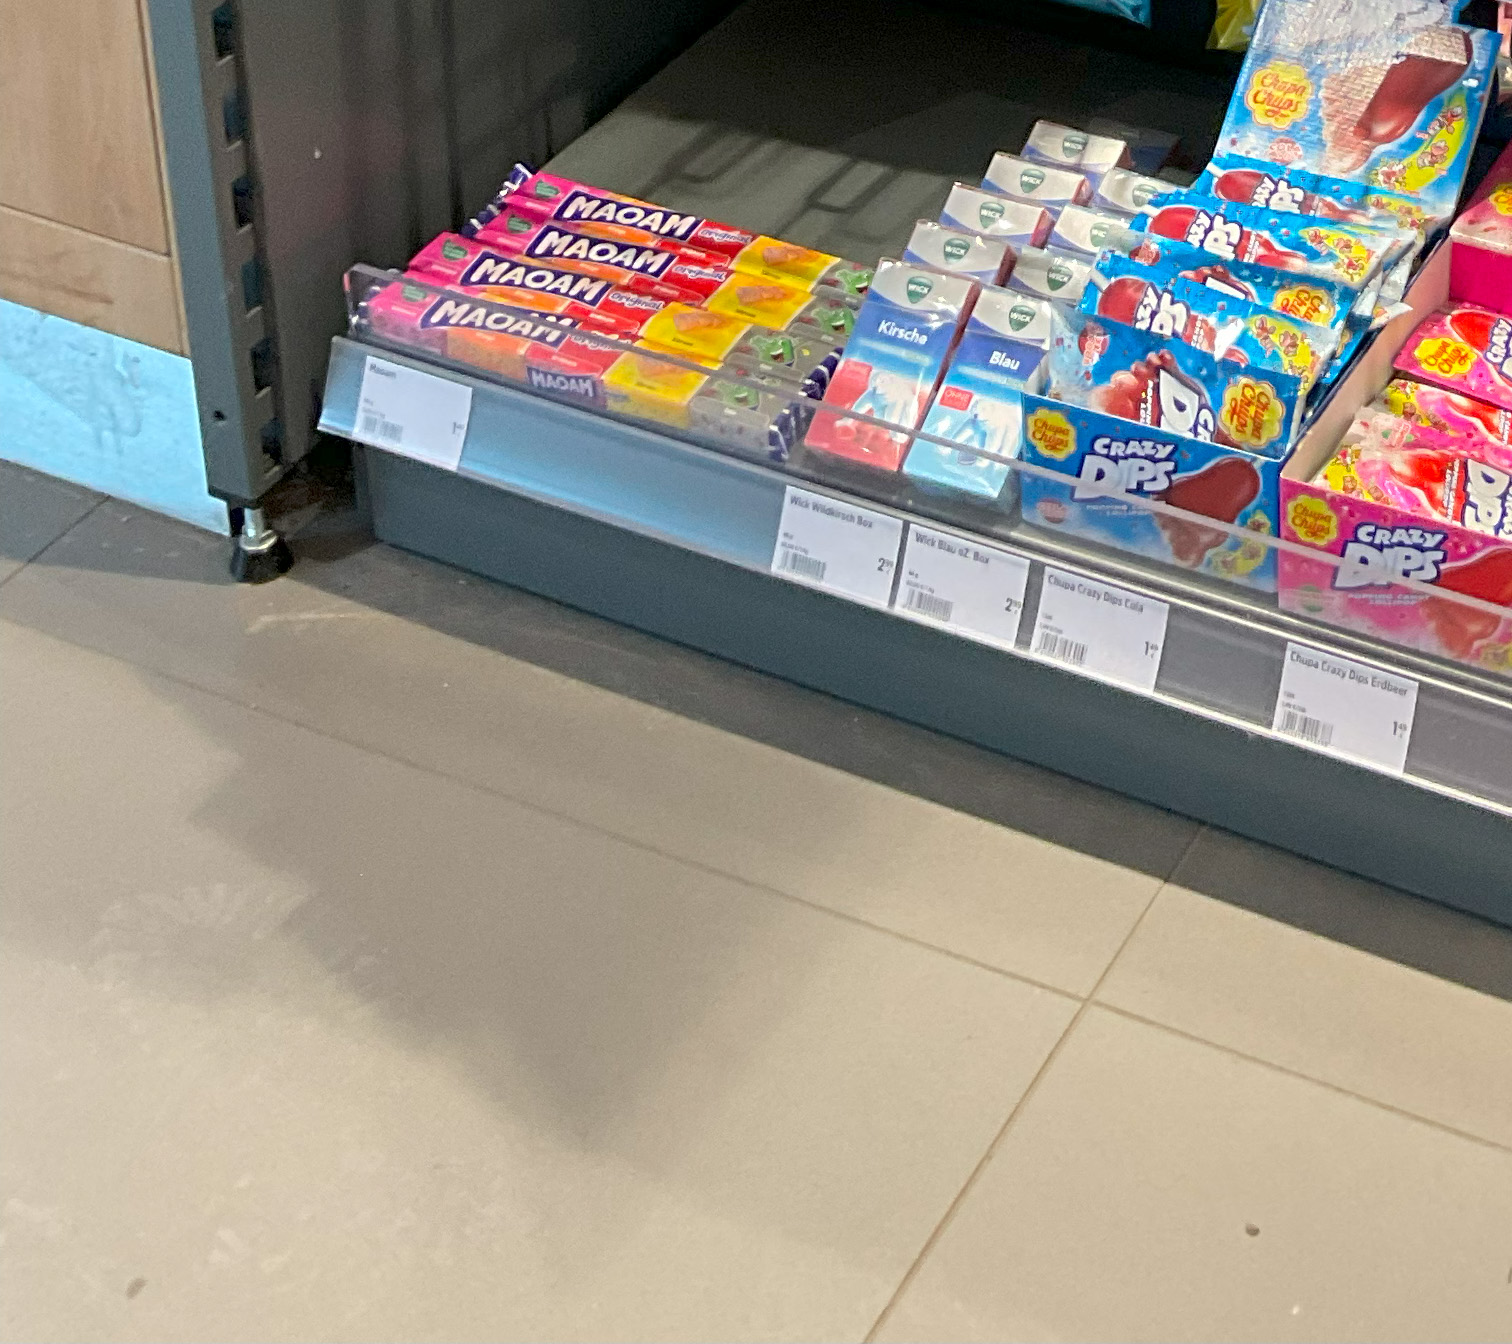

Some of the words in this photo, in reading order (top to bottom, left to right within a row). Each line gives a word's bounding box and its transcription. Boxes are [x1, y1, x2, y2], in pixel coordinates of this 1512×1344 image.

[1259, 66, 1306, 93] Chupa
[560, 191, 698, 239] MAOAM
[698, 228, 753, 245] original
[533, 228, 673, 276] MAOAM
[673, 265, 725, 280] original
[470, 256, 608, 305] MAOAM
[609, 290, 666, 312] original
[907, 284, 929, 295] WICK
[428, 297, 575, 347] MAOAM
[877, 319, 928, 346] Kirsche
[1010, 313, 1032, 324] WICK
[989, 350, 1021, 371] Blau
[531, 369, 596, 395] MAOAM
[1032, 415, 1070, 434] Chupa
[1093, 436, 1175, 461] CRAZY
[1074, 454, 1176, 501] DIPS
[789, 494, 810, 509] Wick
[855, 516, 874, 529] Box
[915, 532, 936, 546] Wick
[938, 538, 958, 552] Blau
[974, 551, 991, 566] Box
[1356, 524, 1446, 549] CRAZY
[1333, 541, 1447, 591] DIPS
[1047, 574, 1076, 592] Chupa
[1077, 582, 1104, 602] Crazy
[1105, 591, 1124, 608] Dips
[1125, 598, 1144, 614] Cola
[1290, 650, 1318, 670] Chupa
[1321, 659, 1349, 680] Crazy
[1351, 669, 1370, 685] Dips
[1371, 675, 1408, 698] Erdbeer
